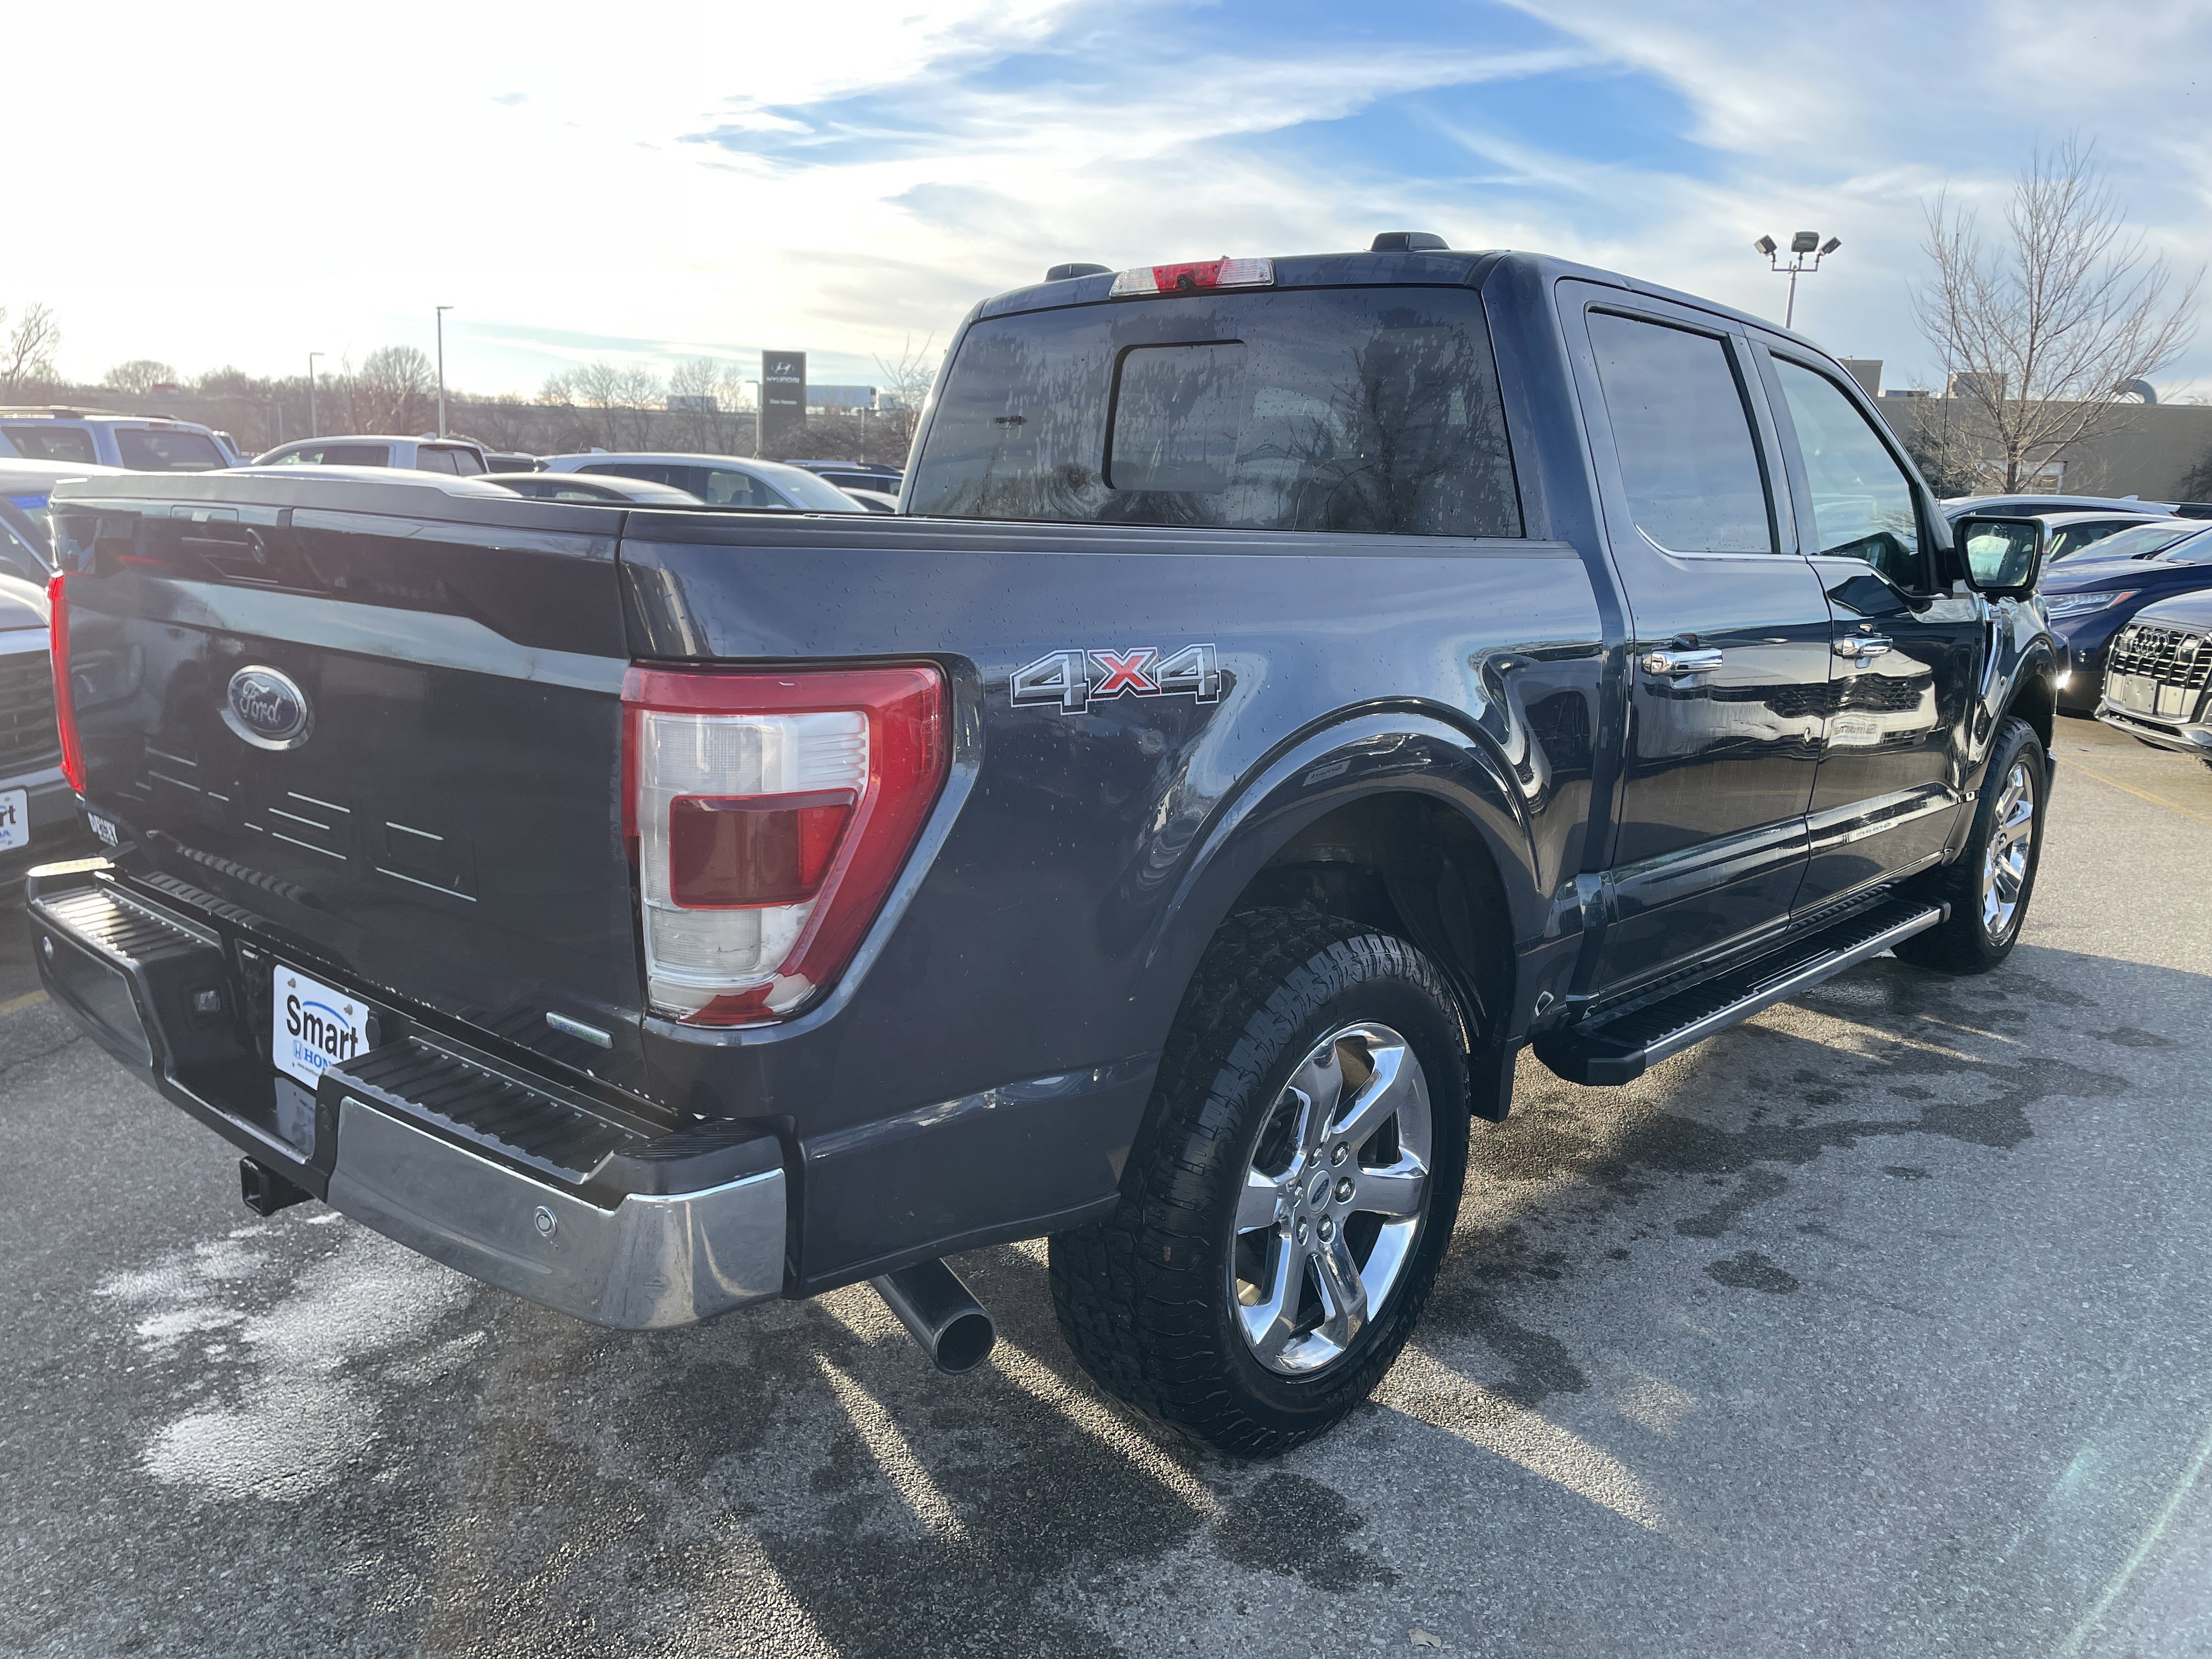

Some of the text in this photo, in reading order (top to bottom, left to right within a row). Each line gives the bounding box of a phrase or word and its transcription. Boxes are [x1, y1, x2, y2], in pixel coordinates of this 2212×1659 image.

[240, 680, 281, 724] Ford
[286, 994, 358, 1060] Smart
[304, 1048, 334, 1070] HON
